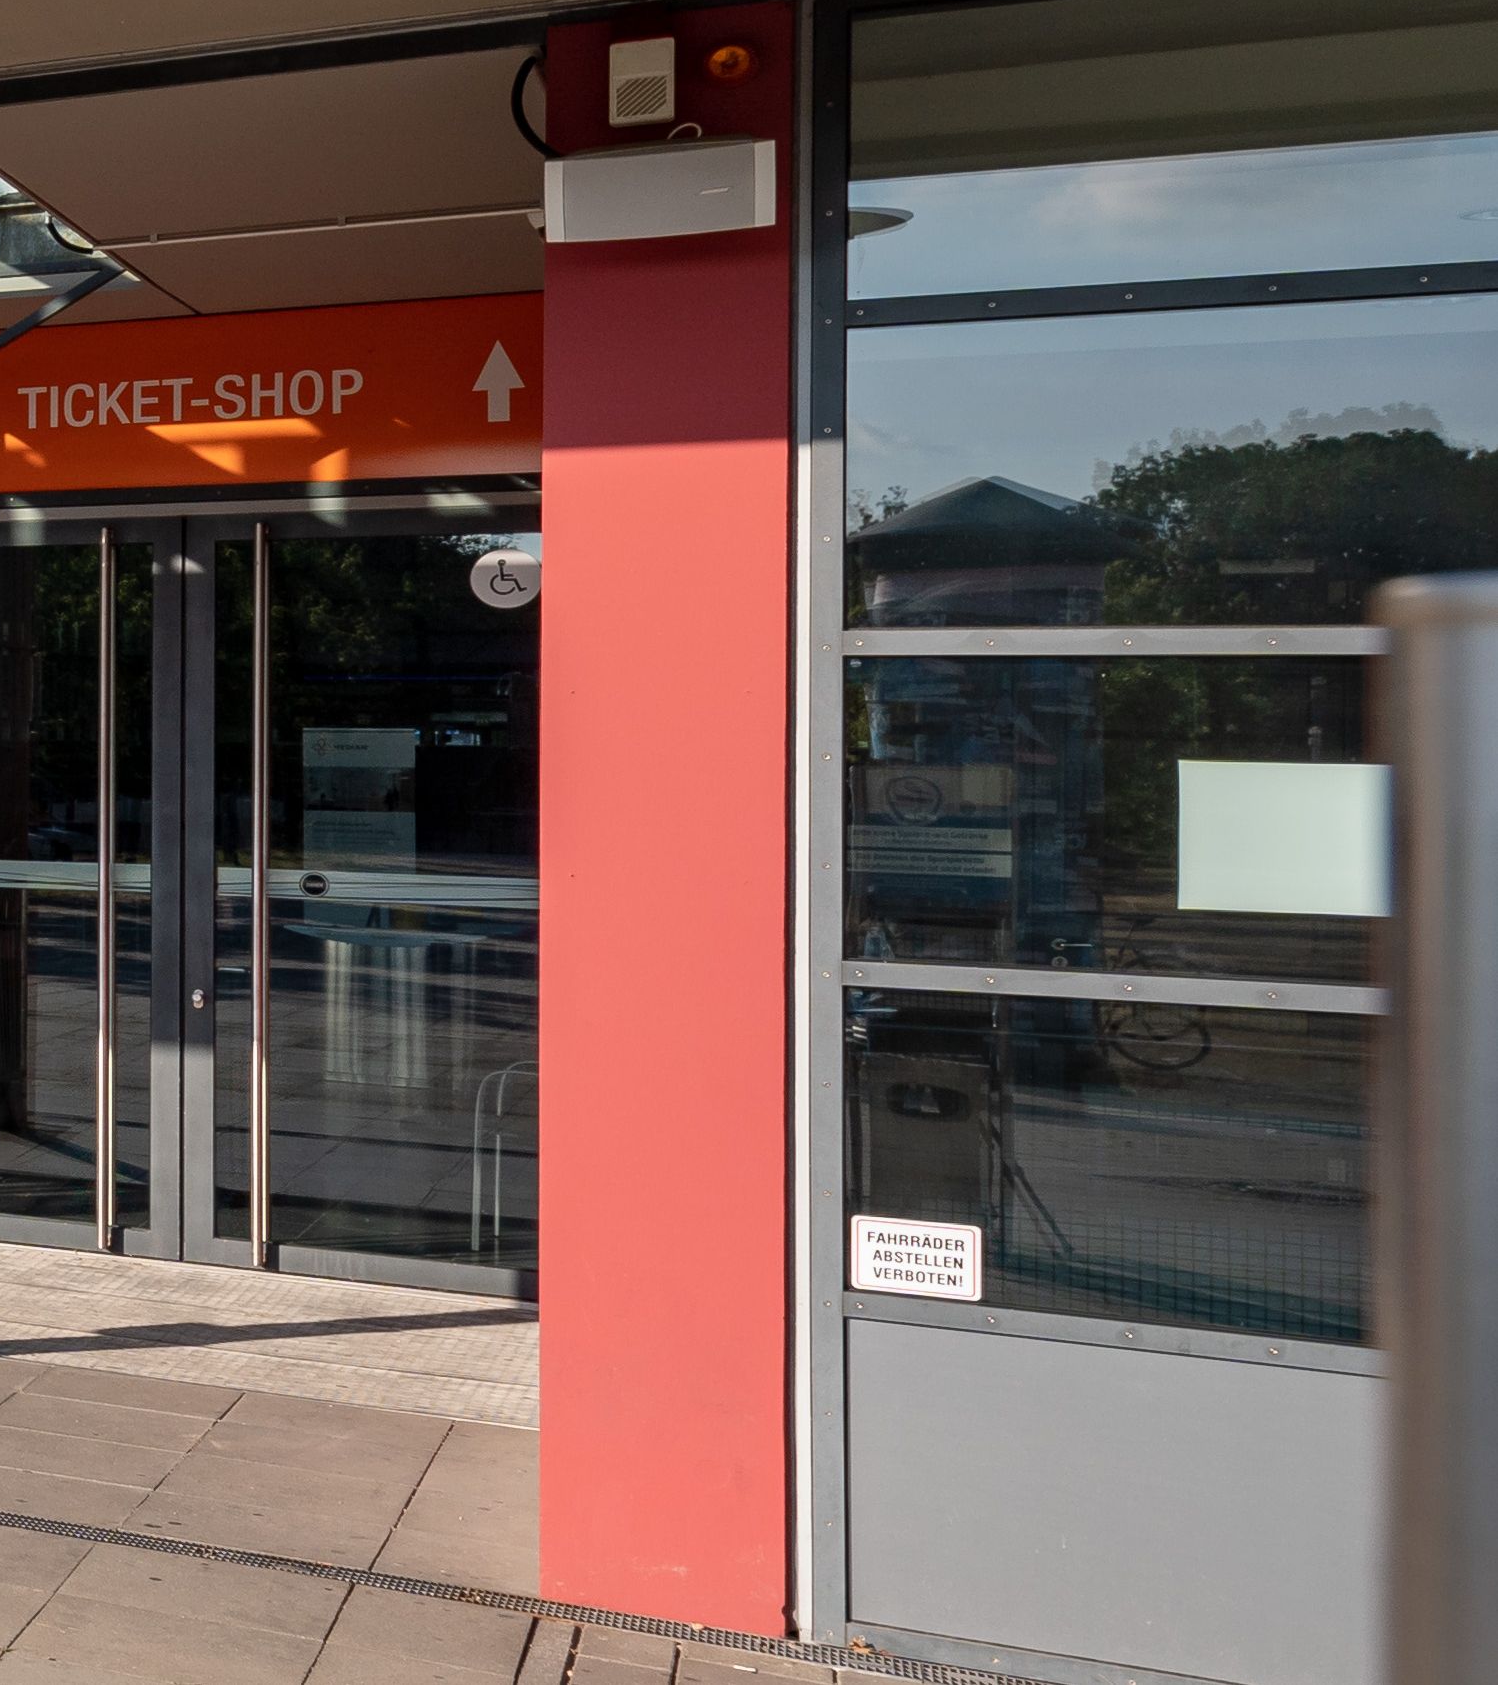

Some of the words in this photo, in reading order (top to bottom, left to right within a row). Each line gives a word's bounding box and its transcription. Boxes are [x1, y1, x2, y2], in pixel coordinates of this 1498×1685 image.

[17, 368, 364, 430] TICKET-SHOP
[867, 1231, 965, 1252] FAHRRÄDER
[873, 1249, 964, 1270] ABSTELLEN
[873, 1266, 963, 1288] VERBOTEN!
